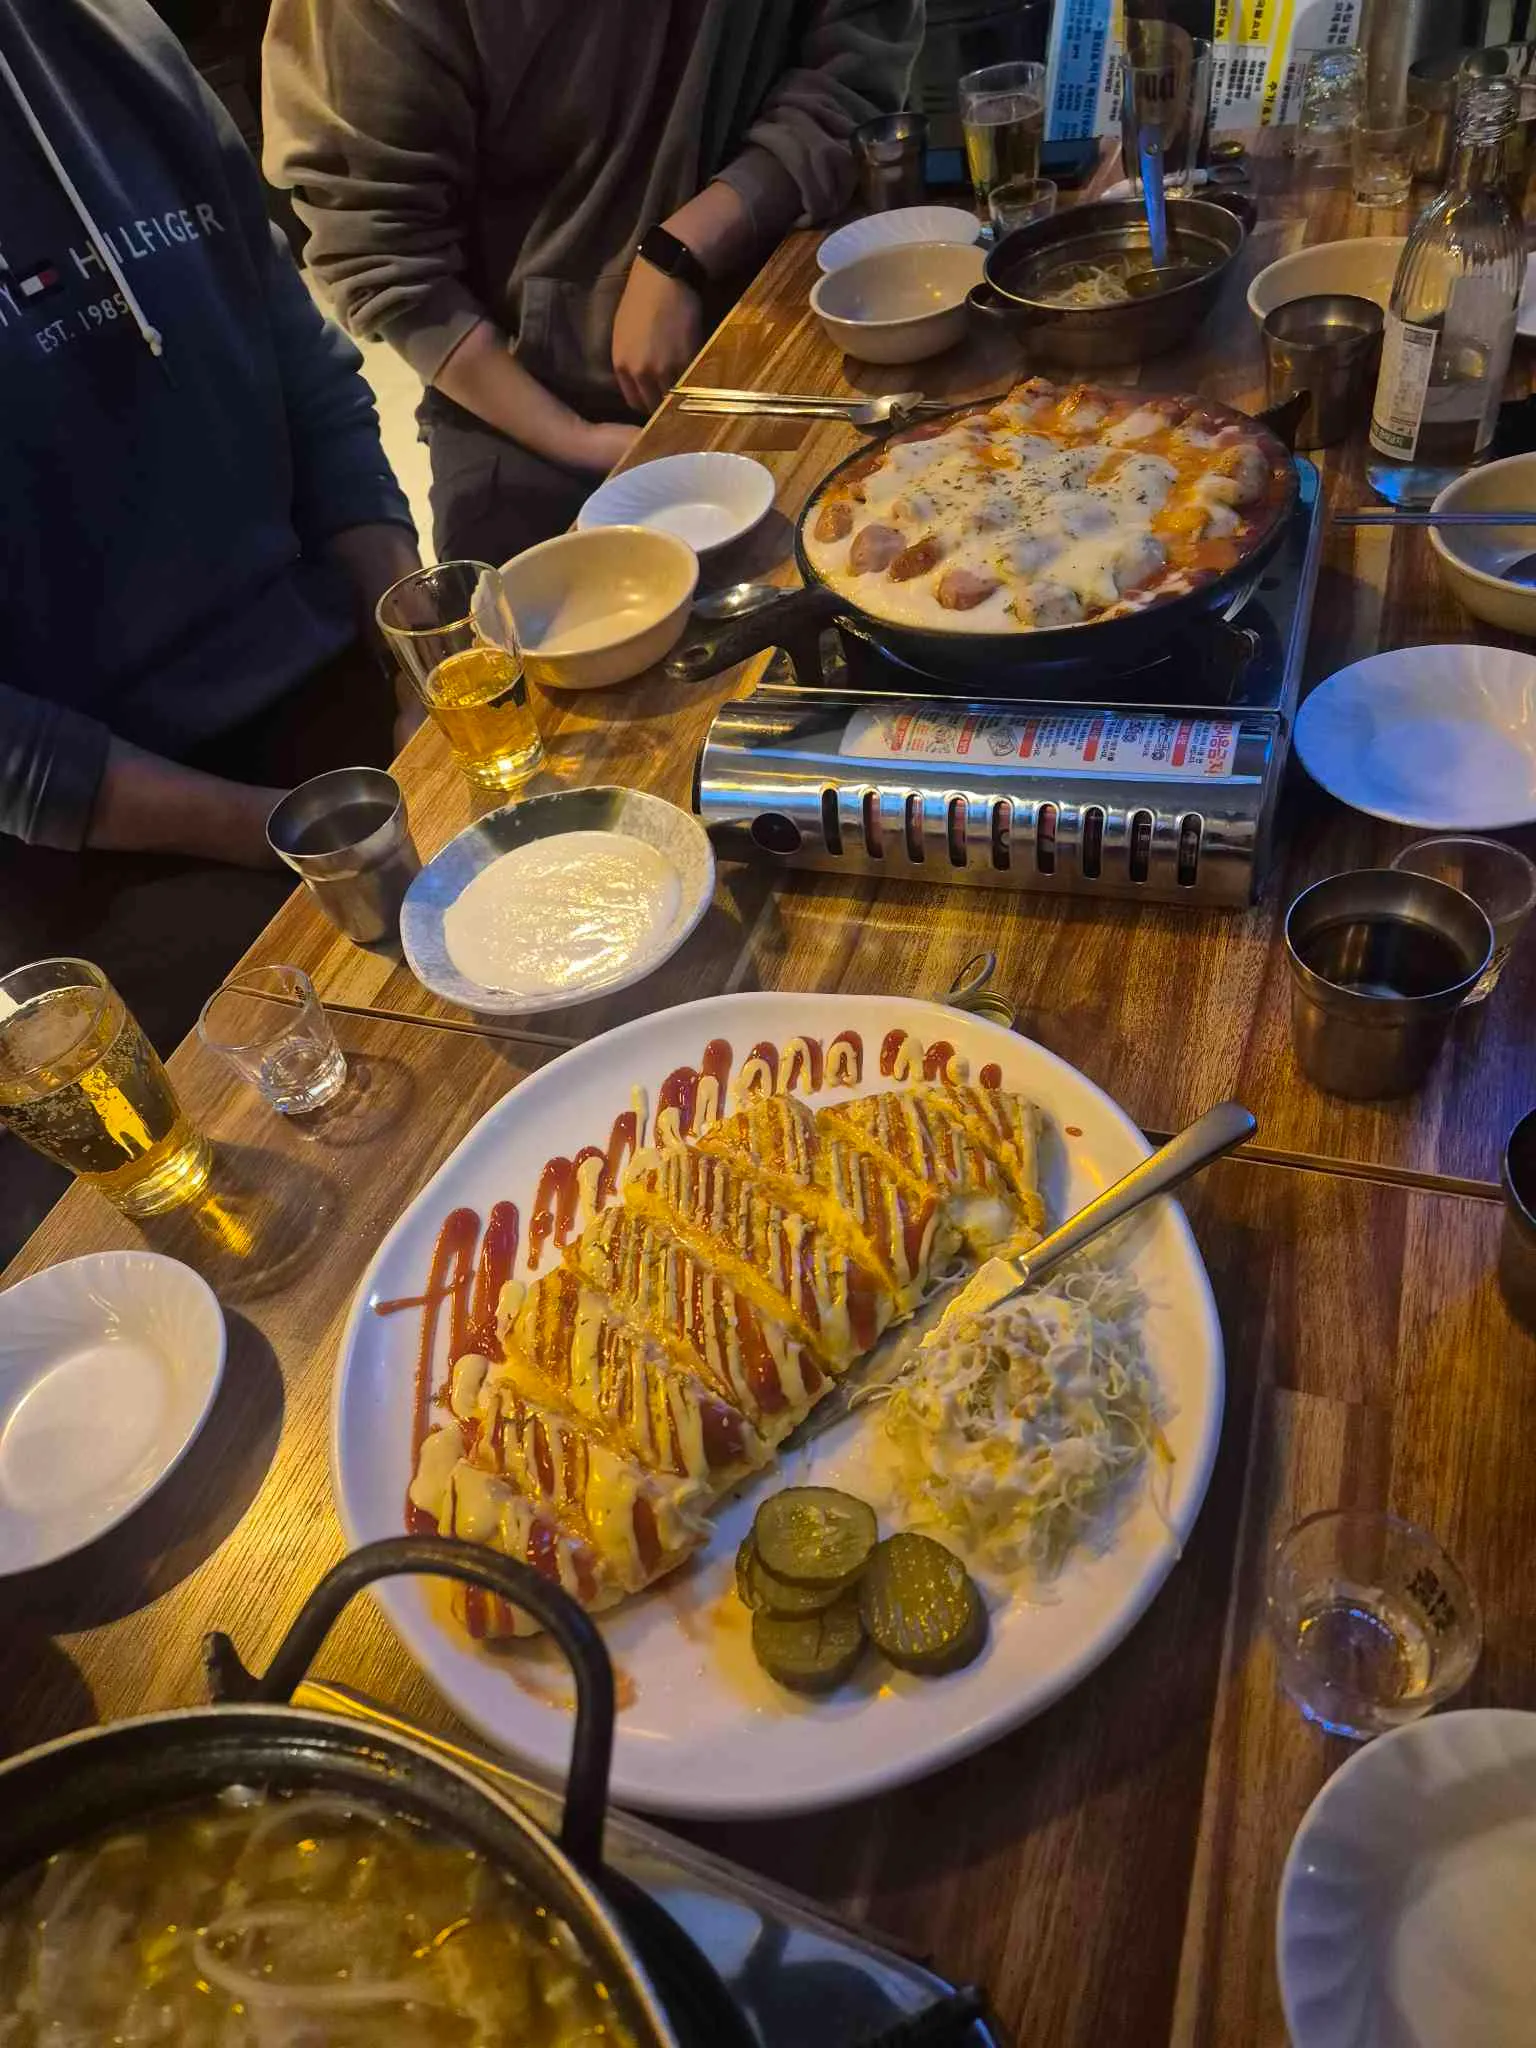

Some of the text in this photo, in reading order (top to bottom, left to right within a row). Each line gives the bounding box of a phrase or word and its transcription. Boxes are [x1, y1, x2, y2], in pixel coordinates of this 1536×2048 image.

[68, 203, 225, 280] HILFIGER
[36, 293, 129, 353] EST. 1985
